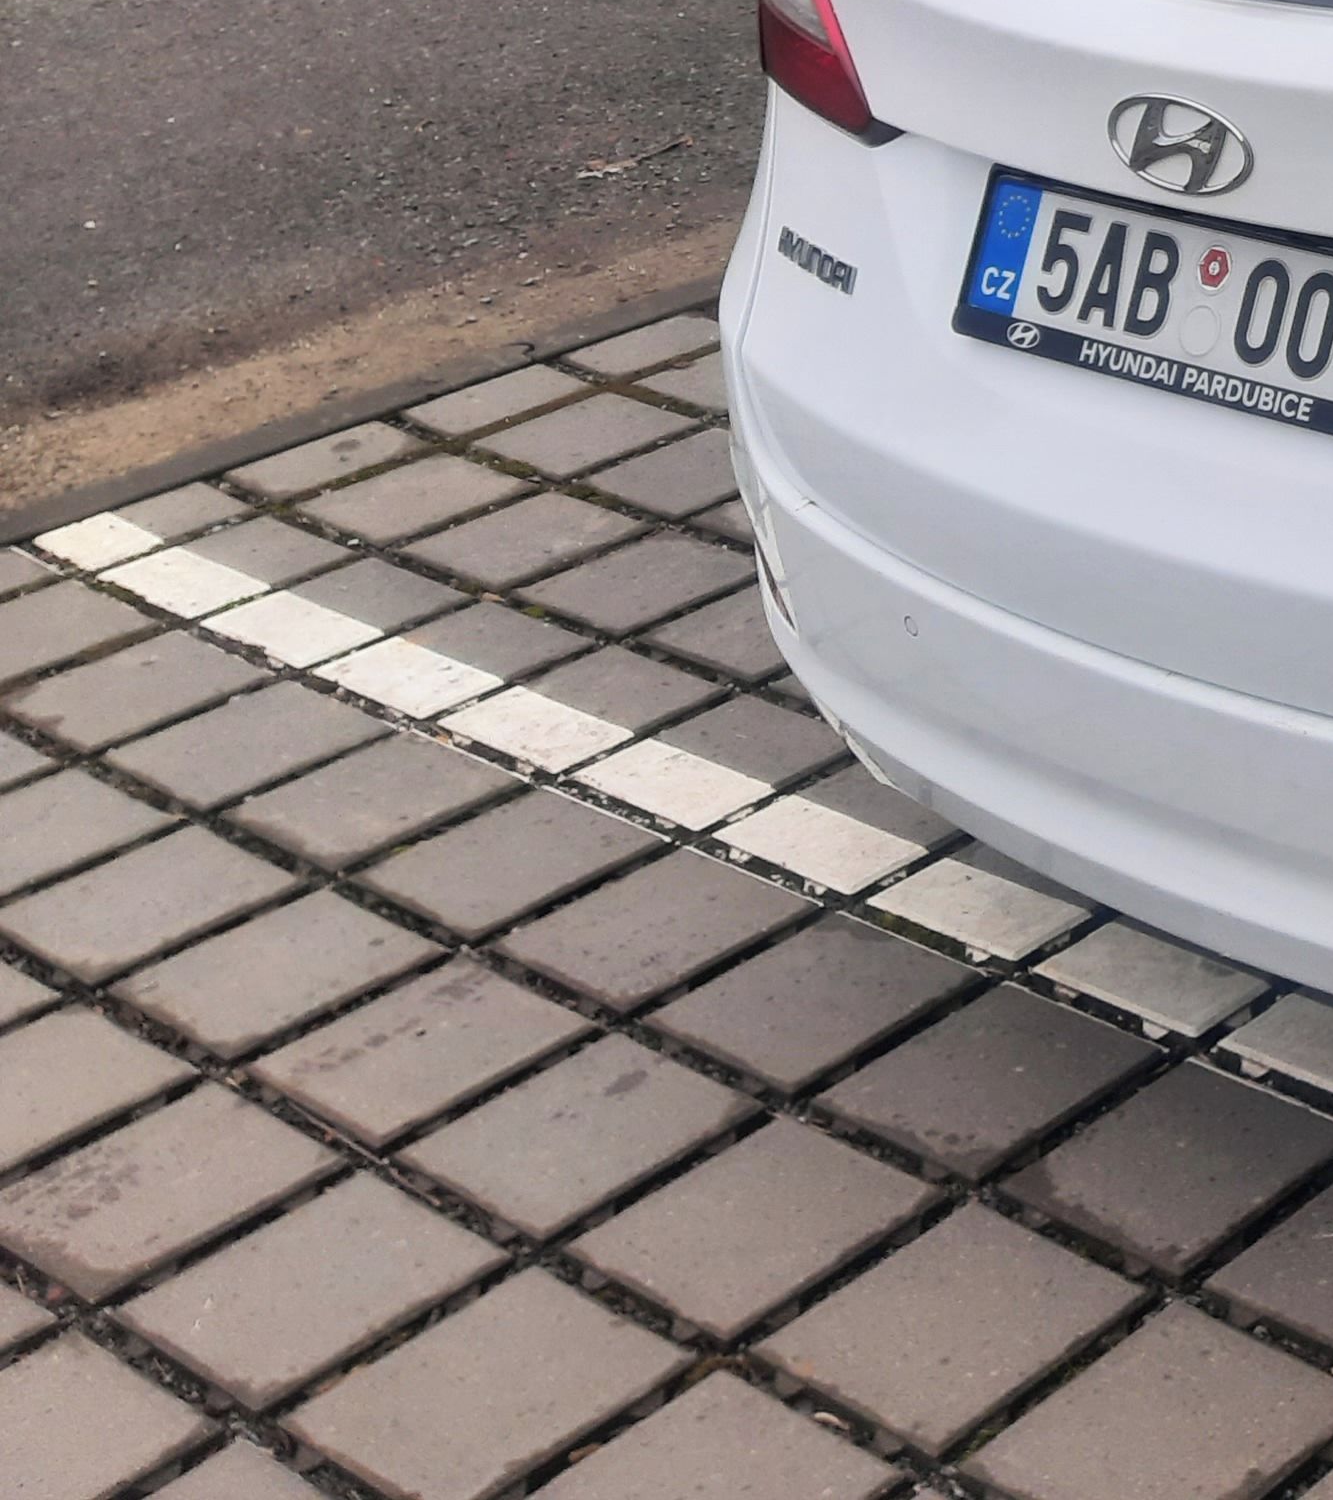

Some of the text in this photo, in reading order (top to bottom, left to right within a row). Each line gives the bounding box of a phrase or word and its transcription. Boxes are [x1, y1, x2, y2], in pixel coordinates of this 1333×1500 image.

[981, 266, 1016, 300] CZ
[1036, 209, 1180, 337] 5AB
[1079, 340, 1314, 422] HYUNDAI PARDUBICE
